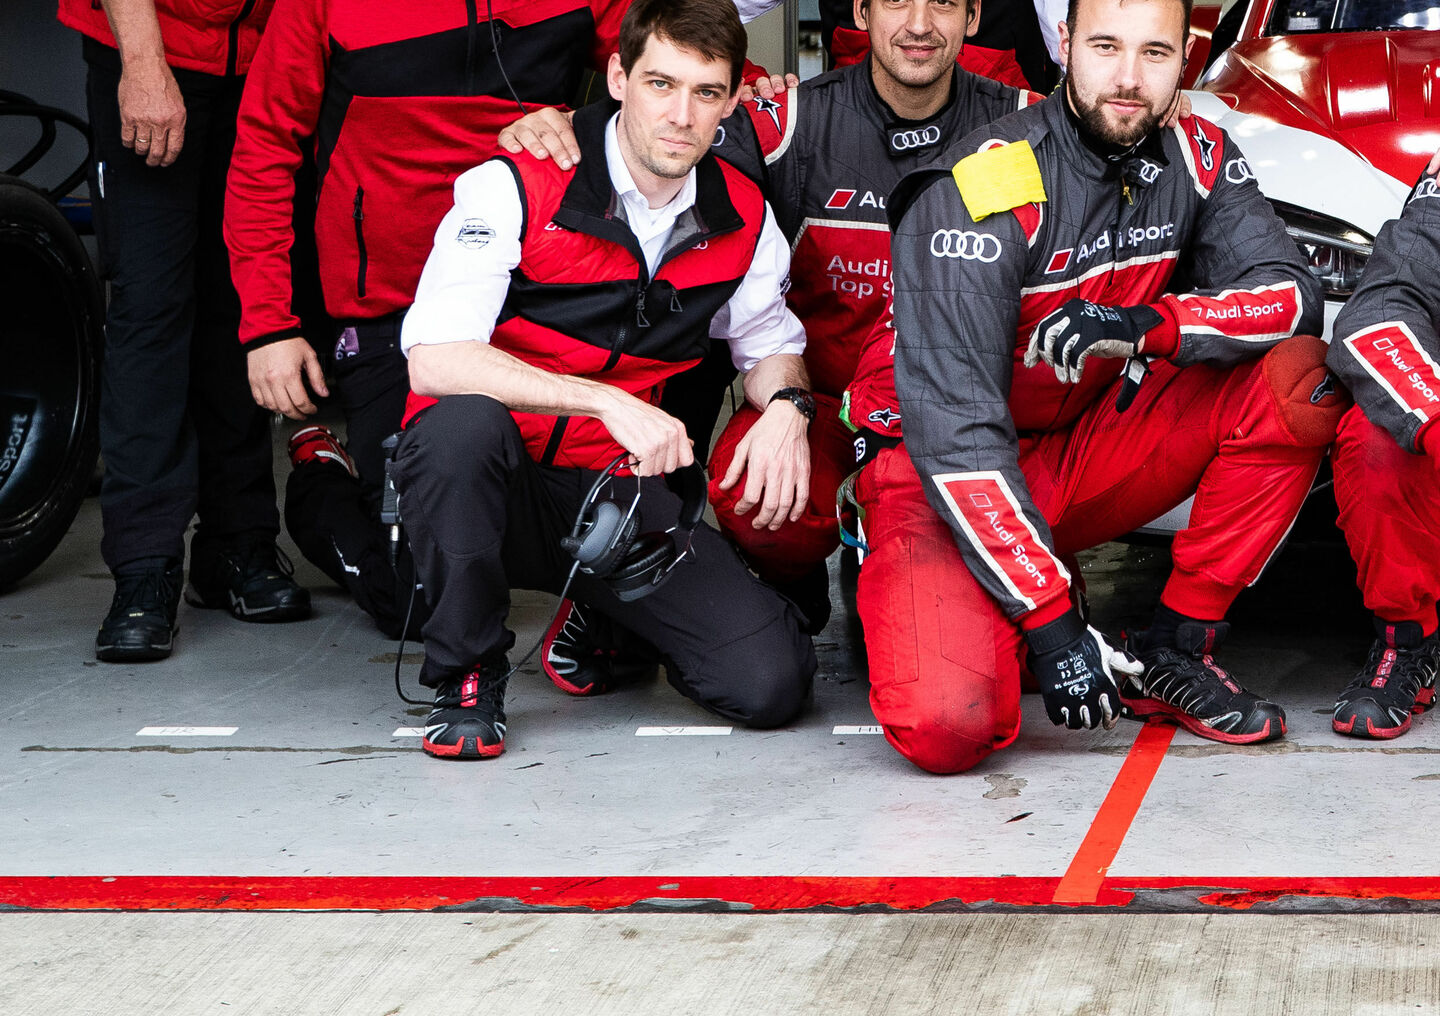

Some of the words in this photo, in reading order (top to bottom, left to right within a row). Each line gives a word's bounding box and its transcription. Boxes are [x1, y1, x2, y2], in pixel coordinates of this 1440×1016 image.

[1127, 221, 1174, 248] Sport
[826, 254, 889, 278] Audi
[826, 273, 874, 300] Top
[1206, 305, 1242, 320] Audi
[1242, 301, 1284, 320] Sport
[1385, 348, 1415, 373] Audi
[1407, 372, 1440, 403] Spor
[984, 510, 1017, 546] Audi
[1011, 543, 1047, 588] Sport
